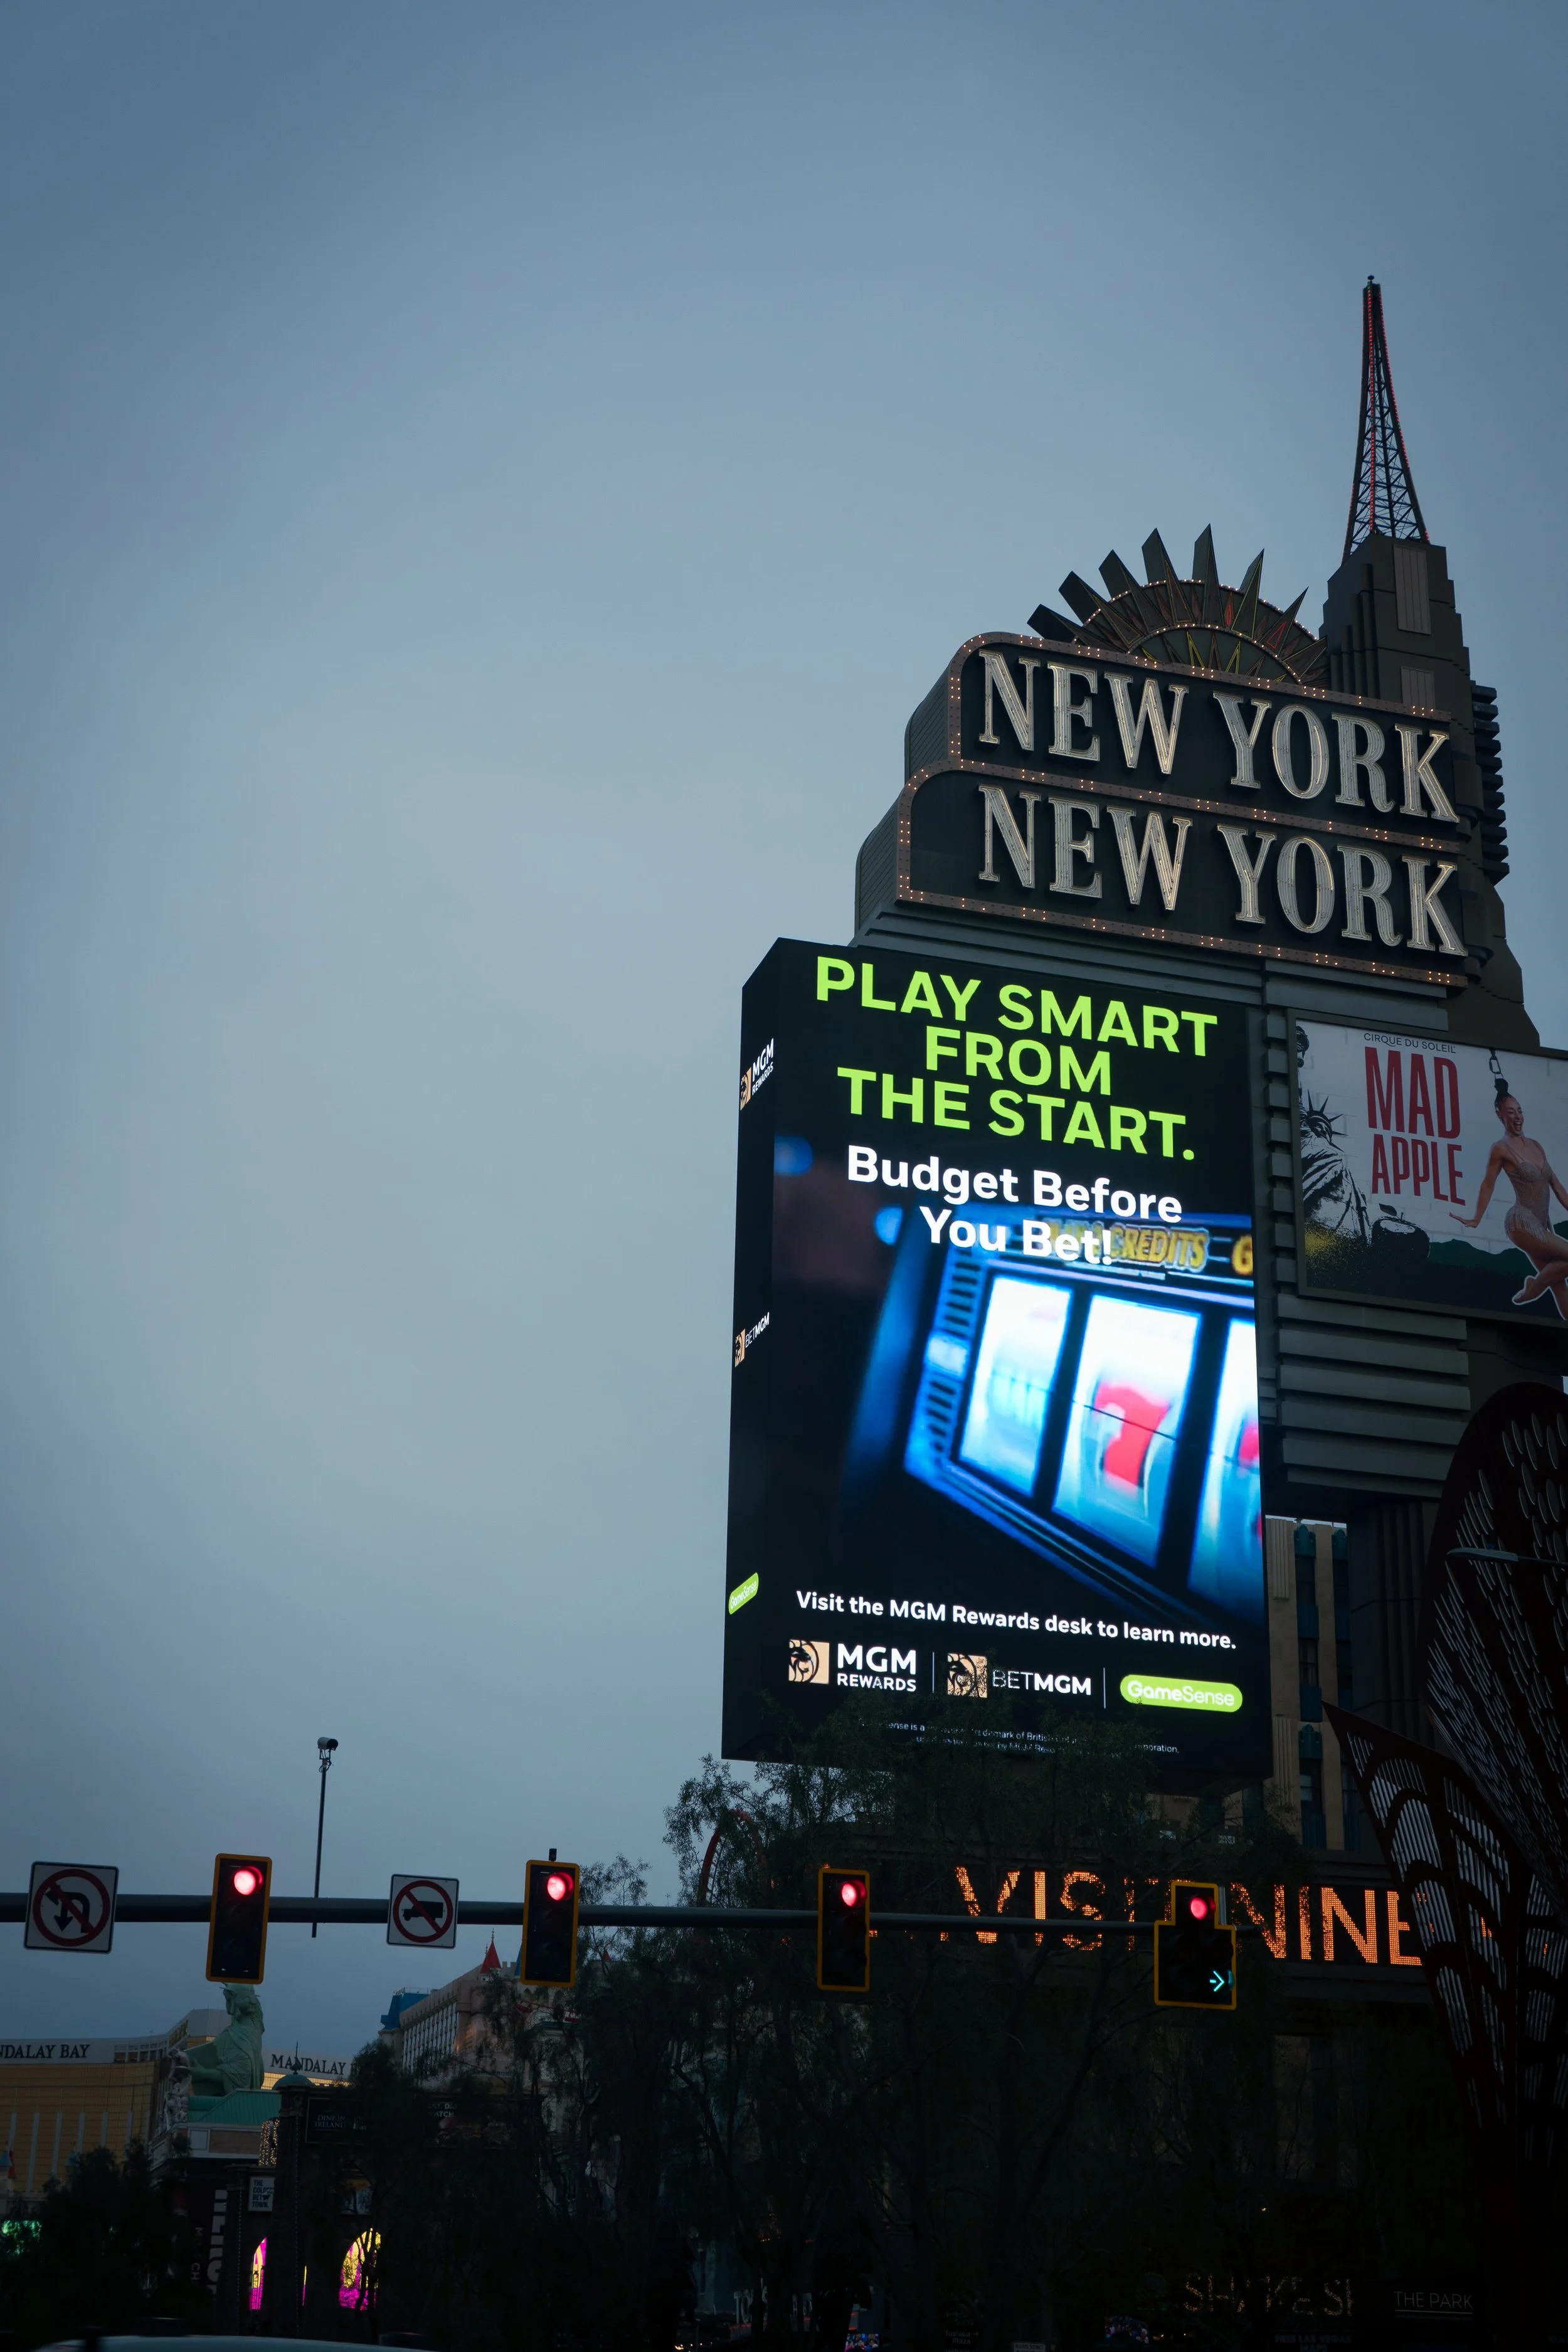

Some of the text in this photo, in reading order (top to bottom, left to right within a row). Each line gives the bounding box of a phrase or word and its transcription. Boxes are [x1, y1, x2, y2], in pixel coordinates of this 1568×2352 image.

[978, 649, 1459, 824] NEW YORK
[977, 783, 1468, 957] NEW YORK
[816, 955, 1219, 1057] PLAY SMART
[752, 1037, 774, 1083] MGM
[925, 1025, 1112, 1097] FROM
[1364, 1032, 1456, 1054] CIRQUE DU SOLEIL
[752, 1061, 773, 1096] REWARDS
[1365, 1046, 1461, 1139] MAD
[836, 1067, 1195, 1162] THE START.
[847, 1144, 1183, 1224] Budget Before
[1372, 1133, 1466, 1206] APPLE
[919, 1205, 1007, 1252] You
[1023, 1219, 1113, 1266] Bet!
[745, 1311, 770, 1348] BETMGM
[796, 1590, 1237, 1650] Visit the MGM Rewards desk to learn more.
[837, 1643, 918, 1675] MGM
[837, 1673, 917, 1692] REWARDS
[992, 1668, 1092, 1696] BETMGM
[1126, 1680, 1236, 1707] GameSense
[60, 2044, 90, 2058] BAY
[1393, 2291, 1474, 2310] THE PARK
